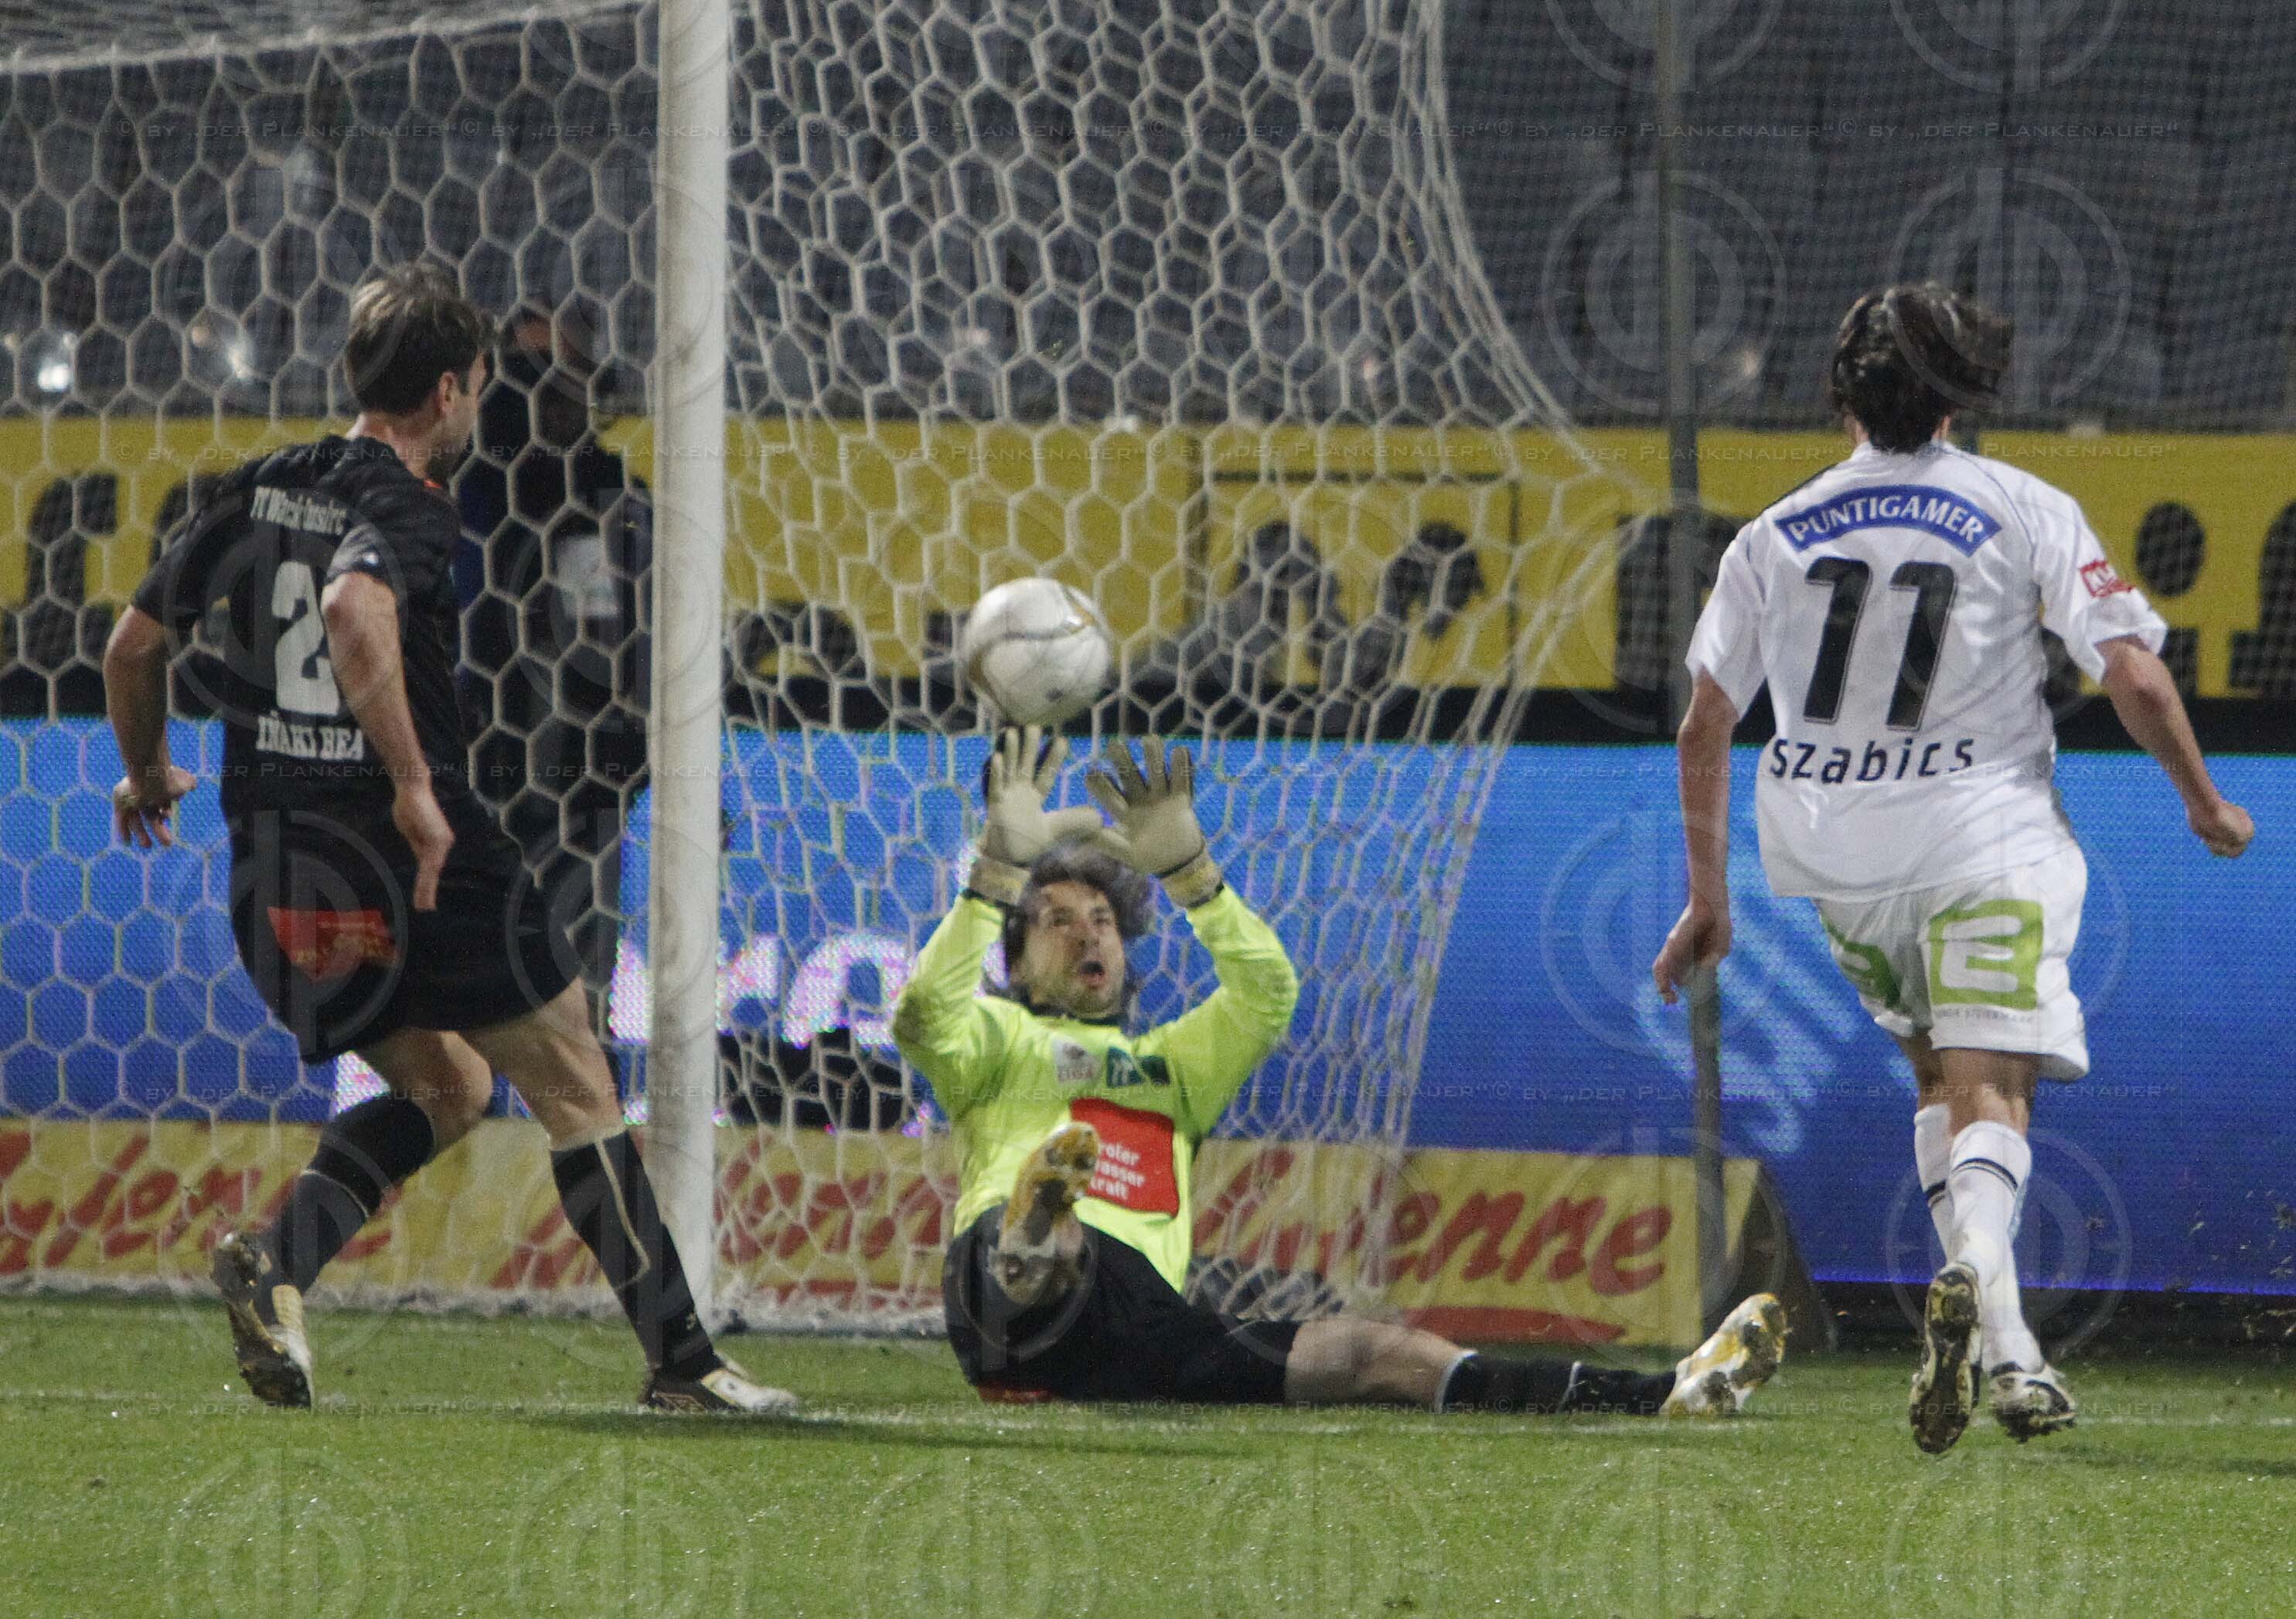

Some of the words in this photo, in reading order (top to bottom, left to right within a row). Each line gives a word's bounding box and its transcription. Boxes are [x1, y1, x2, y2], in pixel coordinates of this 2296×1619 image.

[1787, 495, 1985, 543] PUNTIGAMER
[271, 561, 341, 716] 2
[1804, 556, 1957, 731] 11
[1770, 738, 1975, 784] szabics
